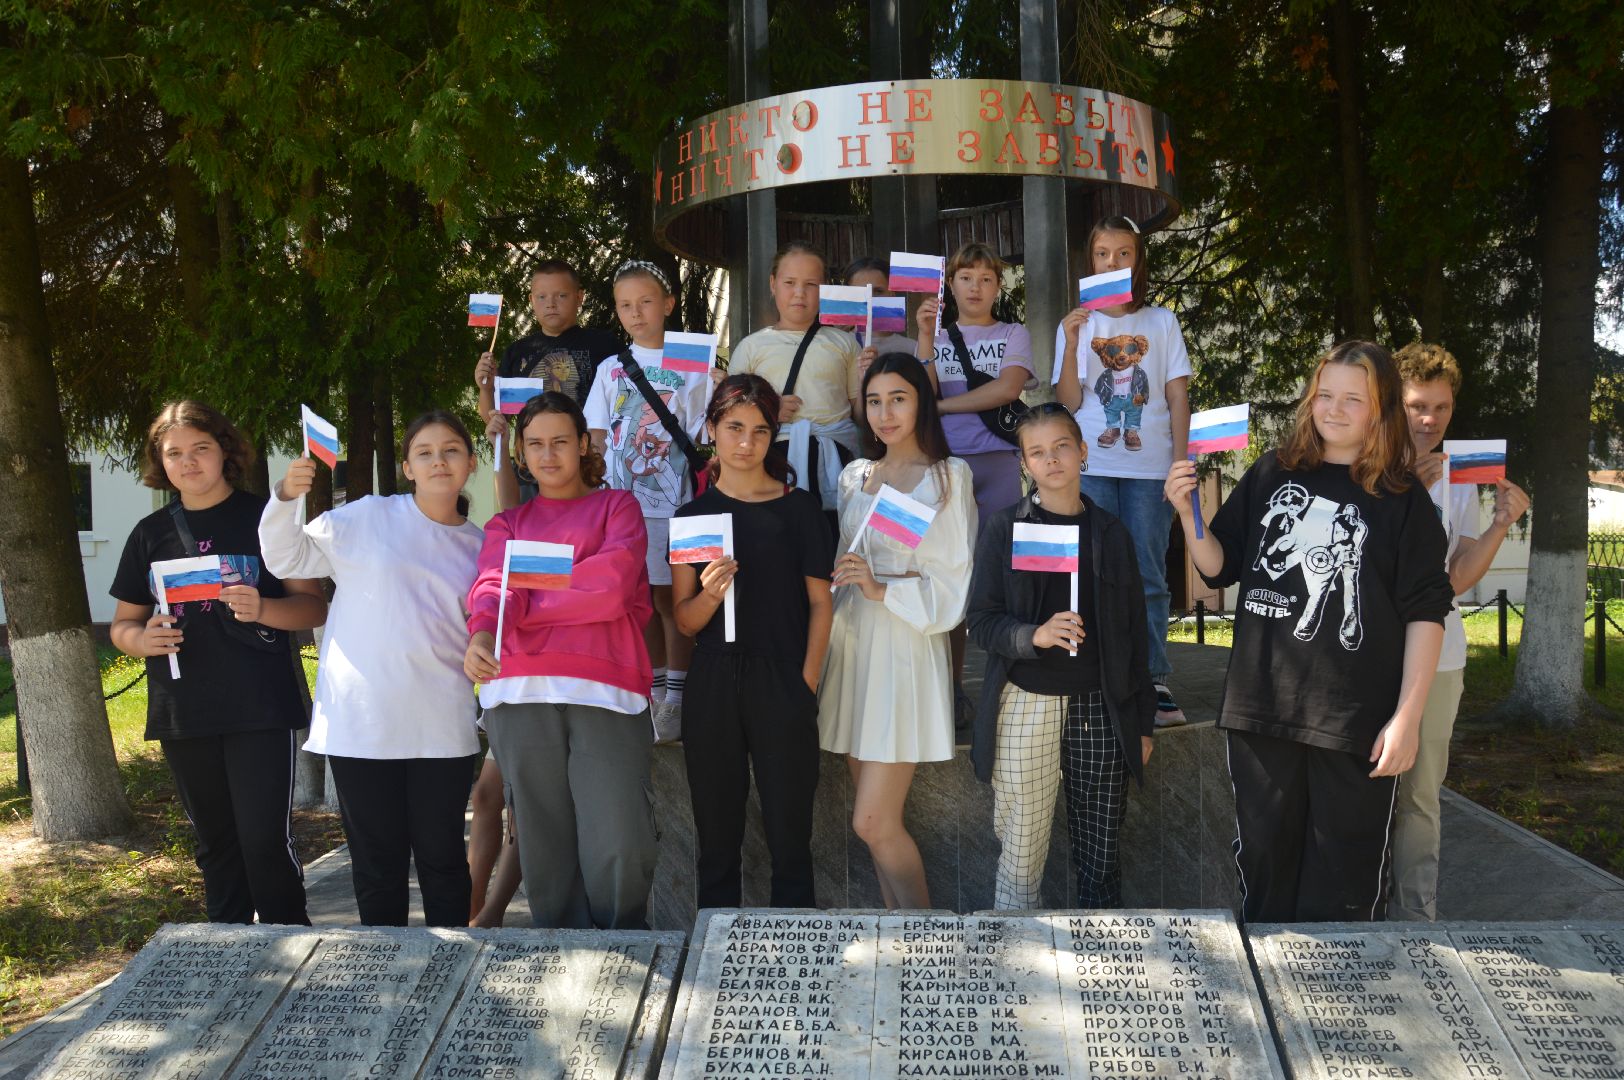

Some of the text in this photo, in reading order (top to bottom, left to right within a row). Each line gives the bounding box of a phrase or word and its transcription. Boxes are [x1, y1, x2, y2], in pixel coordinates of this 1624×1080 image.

[678, 89, 1135, 164] НИКТО НЕ ЗАБЫТ
[838, 132, 915, 167] НЕ
[958, 130, 1148, 177] ЗАБЫТО
[731, 920, 832, 930] АВВАКУМОВ
[1070, 918, 1155, 928] МАЛАХОВ
[904, 933, 964, 942] ЕРЕМИН
[1072, 930, 1150, 939] НАЗАРОВ
[1462, 936, 1543, 944] ШИБЕЛЕВ
[905, 945, 954, 954] ЗИНИН
[1074, 941, 1142, 951] ОСИПОВ
[1280, 940, 1365, 950] ПОТАПКИН
[1469, 946, 1532, 955] ФОМИН
[1076, 954, 1143, 963] ОСЬКИН
[1284, 951, 1361, 960] ПАХОМОВ
[1474, 956, 1538, 965] ФОМИН
[903, 957, 955, 967] ИУДИН
[1288, 961, 1396, 971] ПЕРЕКАТНОВ
[902, 969, 956, 979] ИУДИН
[1077, 966, 1145, 975] ОСОКИН
[1482, 968, 1562, 977] ФЕДУЛОВ
[1291, 972, 1391, 982] ПАНТЕЛЕЕВ
[901, 981, 989, 992] КАРЫМОВ
[1078, 979, 1149, 989] ОХМУШ
[1296, 982, 1365, 993] ПЕШКОВ
[1488, 978, 1552, 989] ФОКИН
[901, 994, 998, 1005] КАШТАНОВ
[1081, 991, 1184, 1001] ПЕРЕЛЫГИН
[1300, 993, 1403, 1004] ПРОСКУРИН
[1495, 990, 1596, 1001] ФЕДОТКИН
[901, 1008, 977, 1018] КАЖАЕВ
[1083, 1004, 1182, 1015] ПРОХОРОВ
[1502, 1003, 1578, 1012] ФРОЛОВ
[901, 1021, 1023, 1032] КАЖАЕВ М.К.
[1085, 1018, 1186, 1029] ПРОХОРОВ
[1308, 1017, 1367, 1028] ПОПОВ
[1087, 1032, 1189, 1043] ПРОХОРОВ
[1313, 1029, 1395, 1041] ПИСАРЕВ
[1514, 1026, 1605, 1038] ЧУГУНОВ
[900, 1035, 1027, 1047] КОЗЛОВ М.А.
[1523, 1039, 1616, 1051] ЧЕРЕПОВ
[1088, 1046, 1182, 1058] ПЕКИШЕВ
[1317, 1041, 1403, 1053] РАССОХА
[898, 1050, 1028, 1061] КИРСАНОВ А.И.
[1322, 1053, 1384, 1065] РУНОВ
[1531, 1053, 1614, 1065] ЧЕРНОВ
[898, 1064, 1028, 1076] КАЛАШНИКОВ
[1090, 1061, 1156, 1073] РЯБОВ
[1327, 1066, 1413, 1078] РОГАЧЕВ
